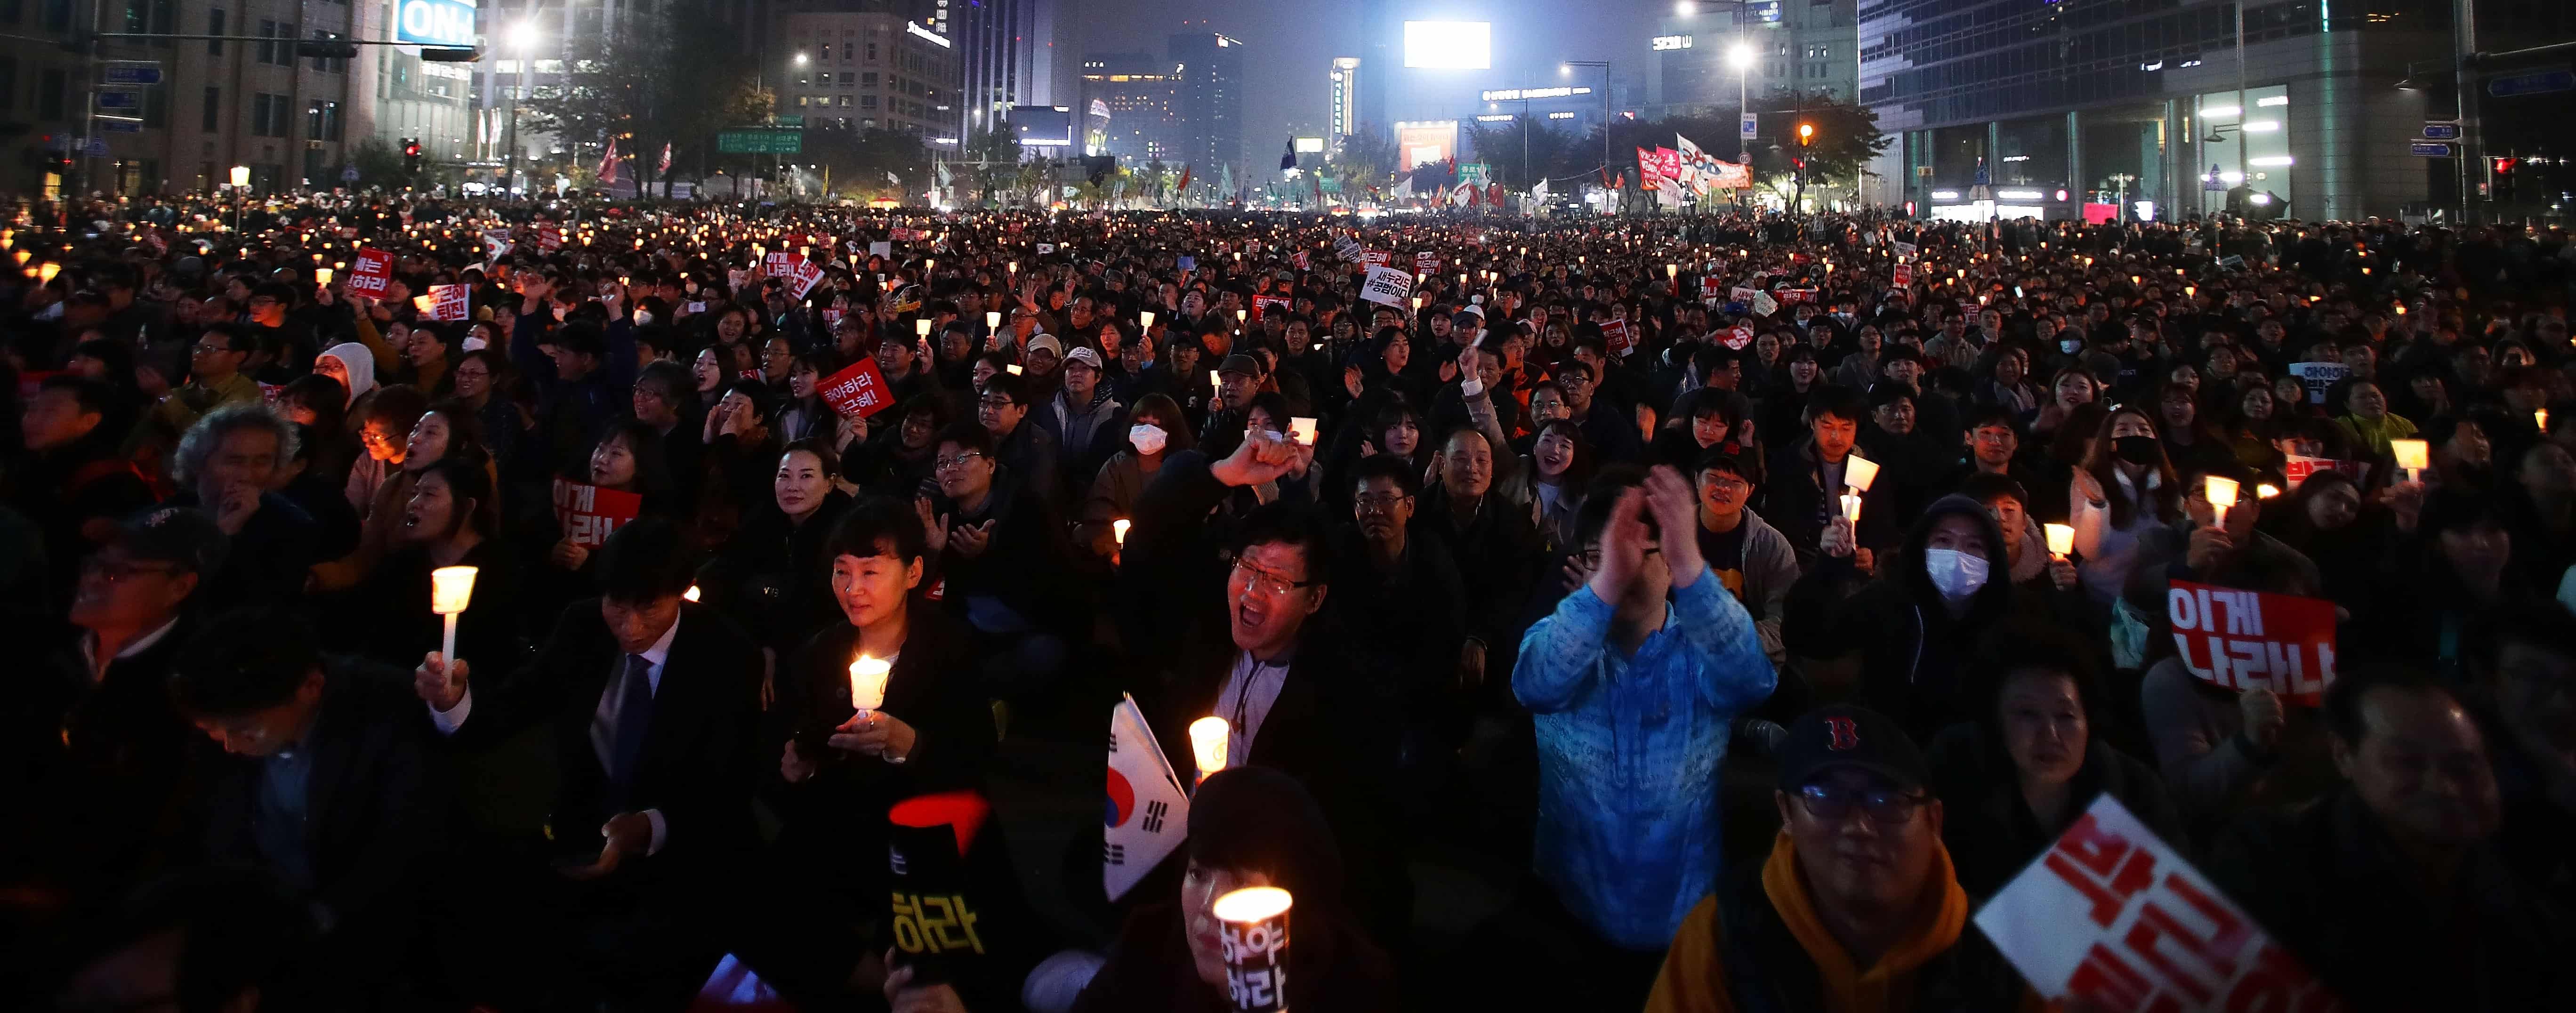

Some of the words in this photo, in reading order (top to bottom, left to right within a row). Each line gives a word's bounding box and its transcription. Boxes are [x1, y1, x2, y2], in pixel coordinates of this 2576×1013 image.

[767, 252, 788, 264] 이게
[1361, 252, 1387, 263] 박근혜
[1416, 259, 1440, 269] 박근혜
[1376, 271, 1410, 289] 새누리도
[1738, 290, 1755, 298] 새누리
[1603, 327, 1623, 338] 박근혜
[824, 371, 873, 402] 하야하라
[553, 479, 595, 513] 이게
[2168, 587, 2265, 636] 이게
[1825, 718, 1860, 750] B
[892, 892, 985, 954] 하라
[1226, 964, 1287, 1011] 하라
